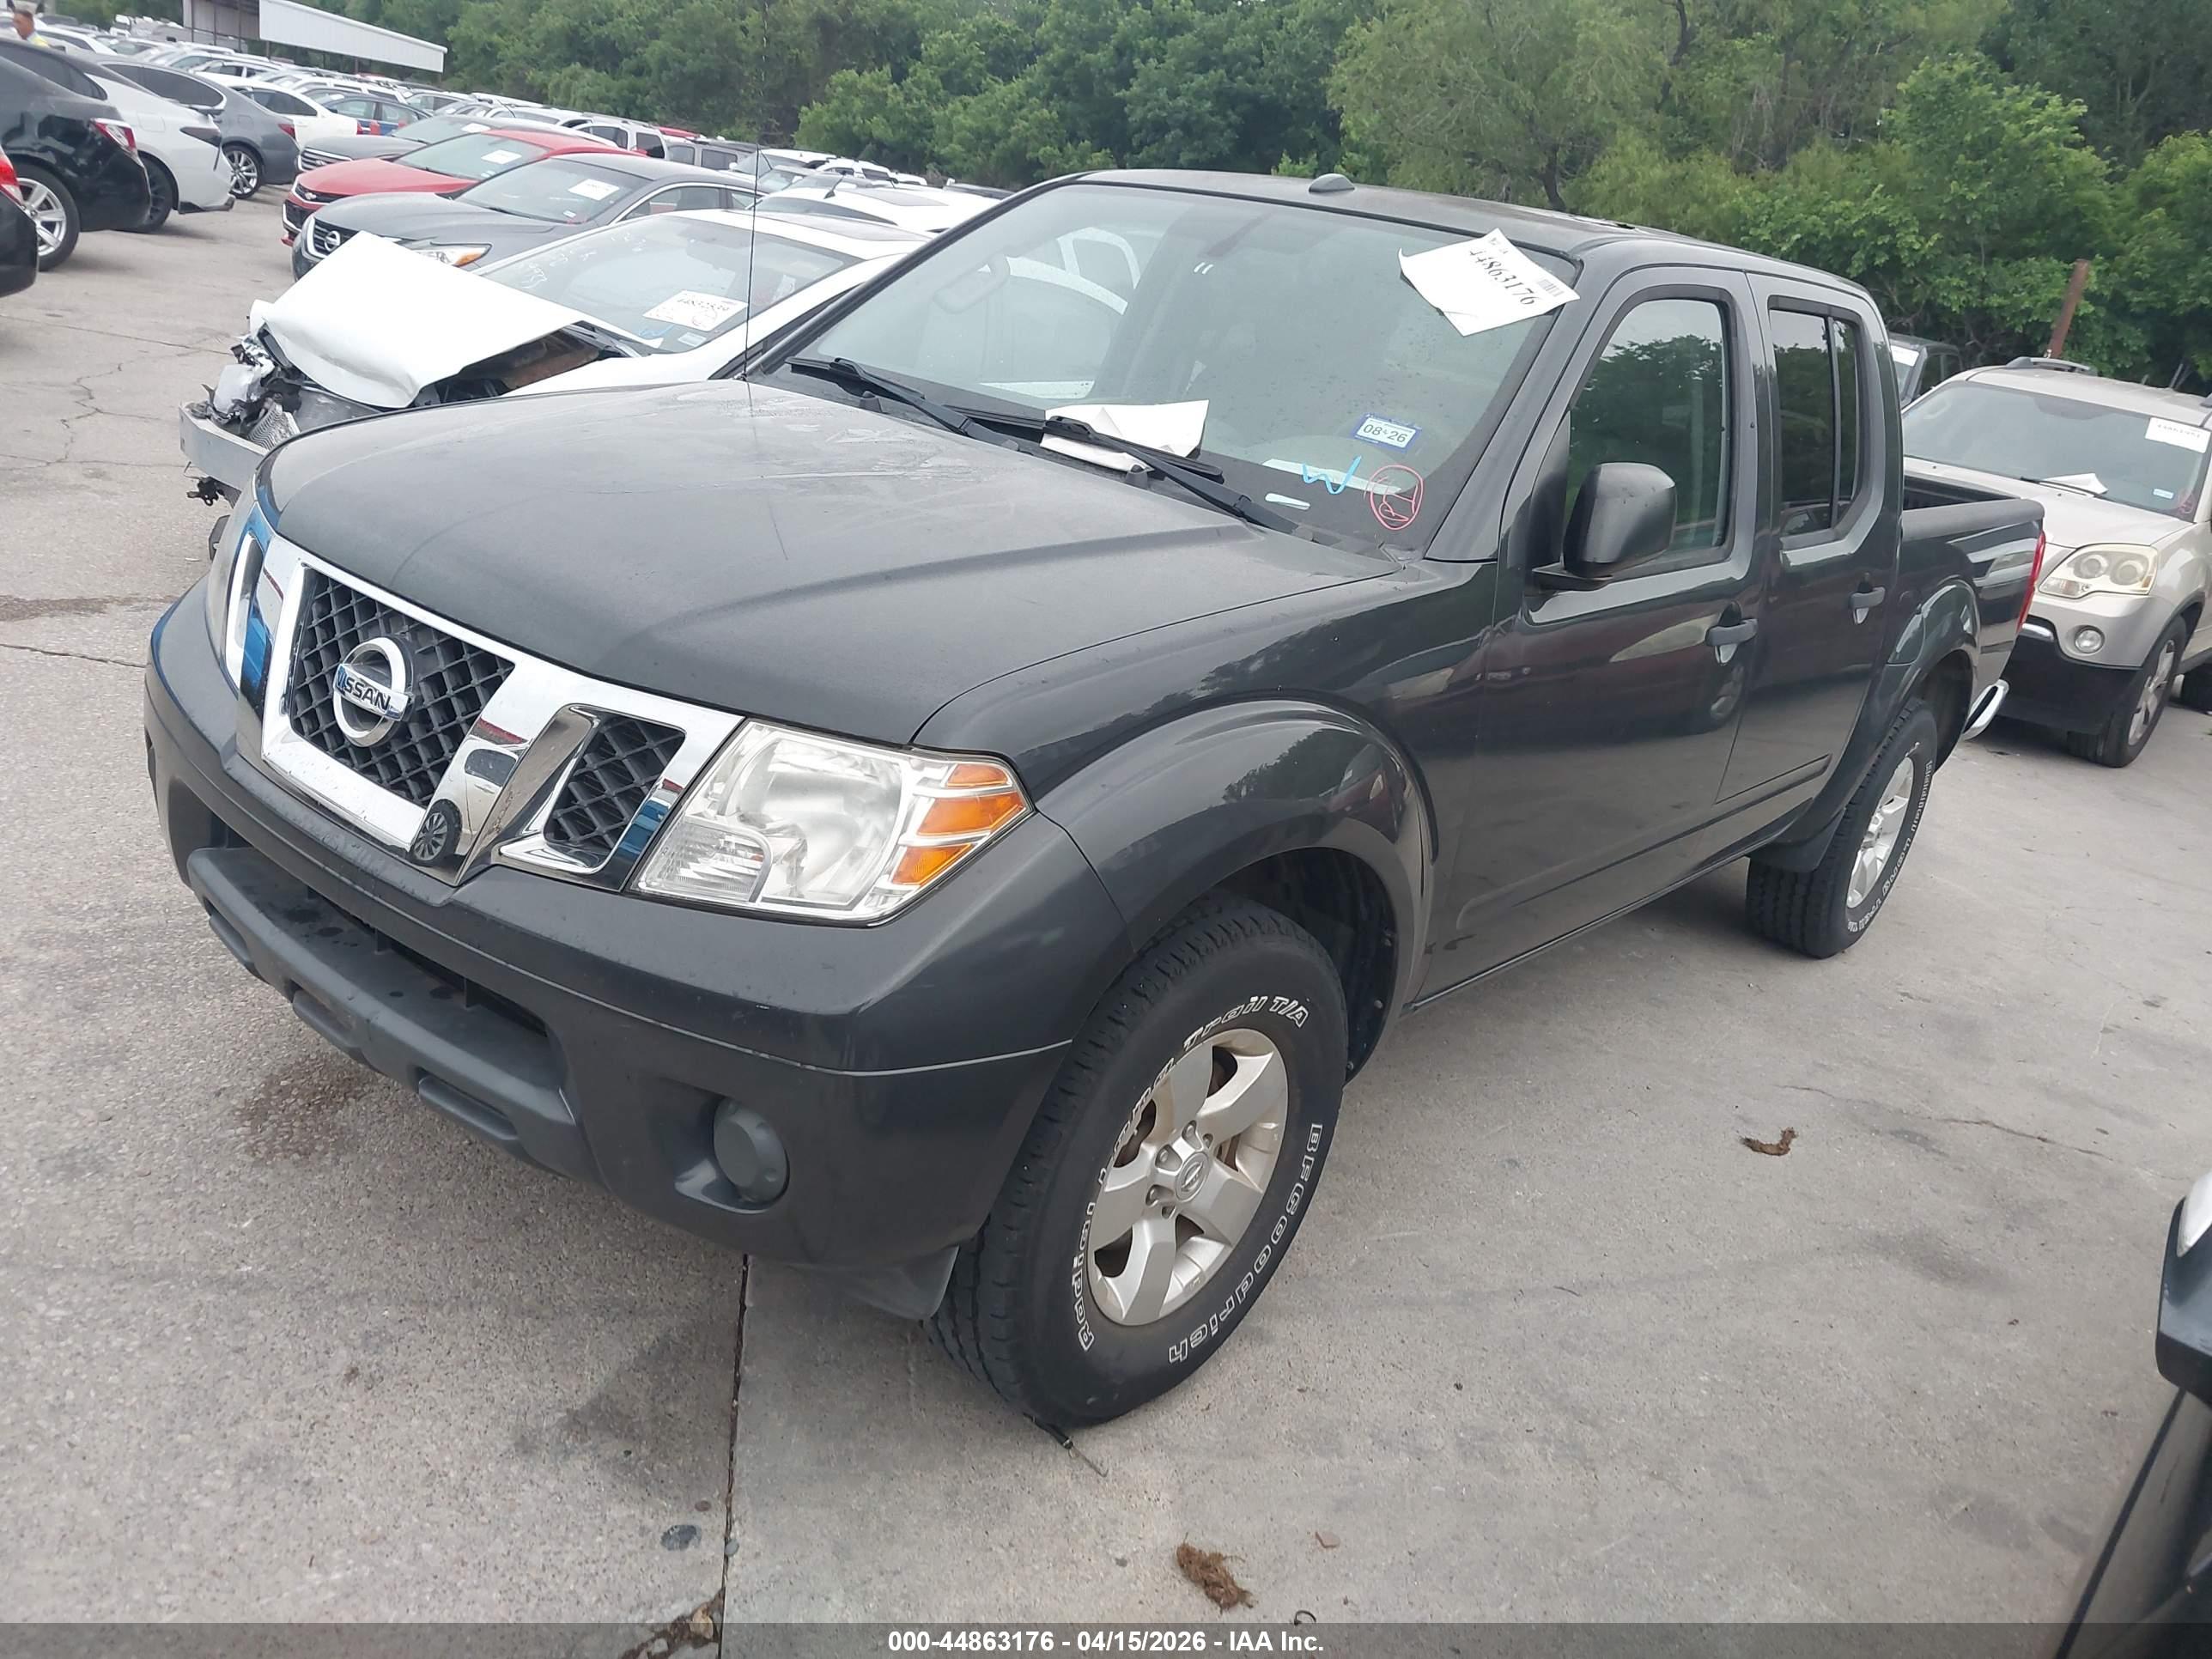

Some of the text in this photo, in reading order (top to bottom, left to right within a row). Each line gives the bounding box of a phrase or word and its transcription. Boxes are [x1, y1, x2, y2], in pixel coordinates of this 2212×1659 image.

[1363, 423, 1382, 435] 08
[1387, 430, 1408, 443] 26
[337, 670, 392, 712] NISSAN
[1272, 994, 1310, 1029] T/A
[1168, 1123, 1324, 1364] BFGoodrich
